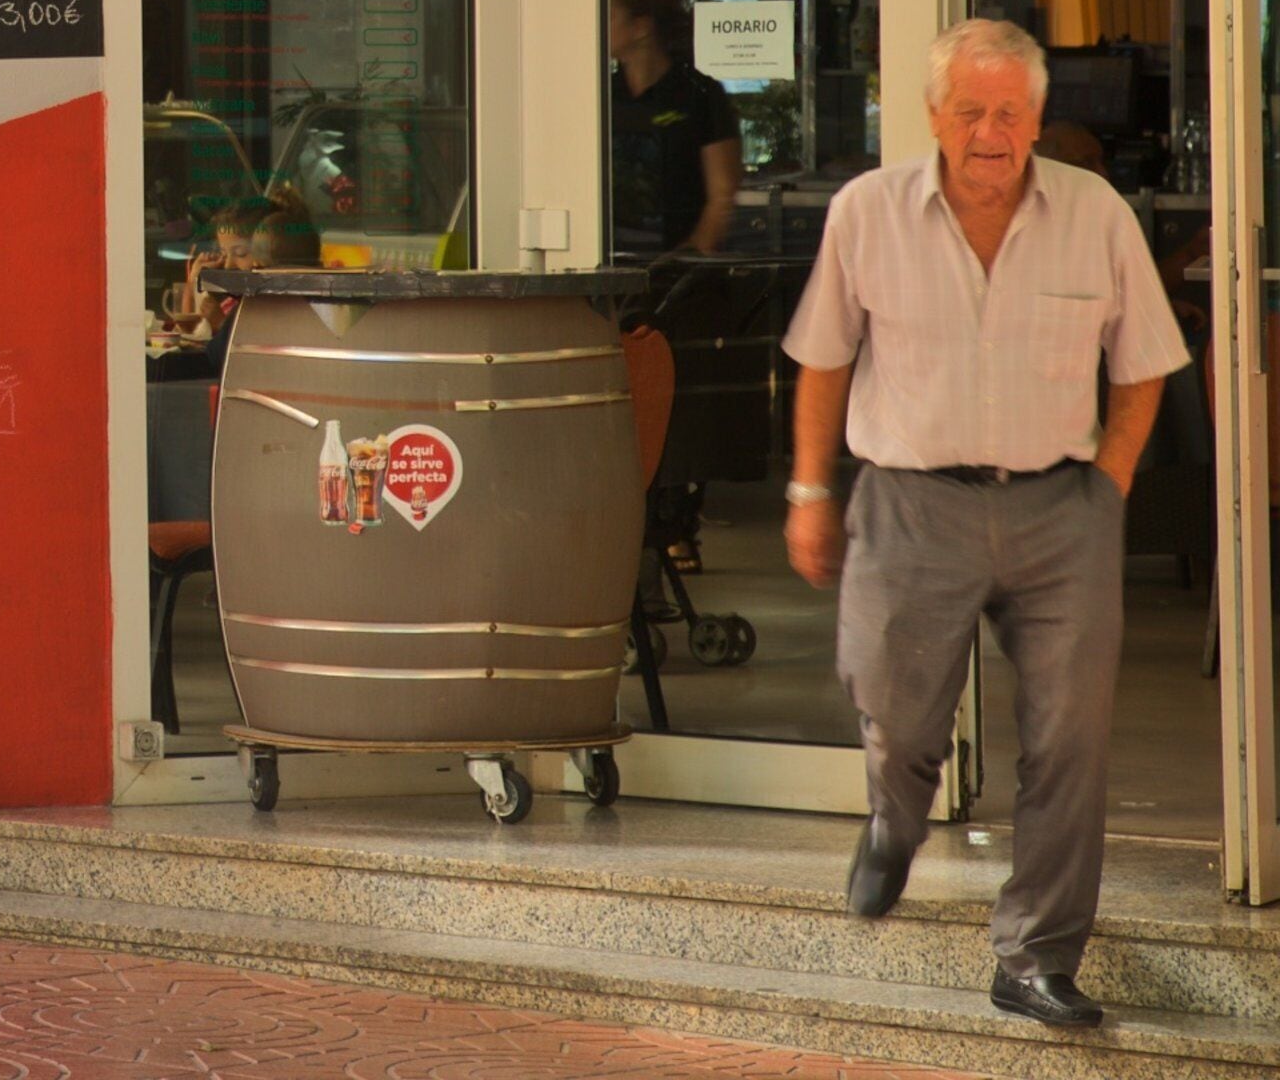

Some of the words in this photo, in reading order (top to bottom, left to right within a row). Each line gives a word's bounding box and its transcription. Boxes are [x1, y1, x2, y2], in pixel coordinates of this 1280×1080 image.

[711, 19, 777, 34] HORARIO
[401, 444, 434, 461] Aquí
[391, 459, 408, 470] se
[410, 457, 444, 470] sirve
[388, 471, 447, 485] perfecta
